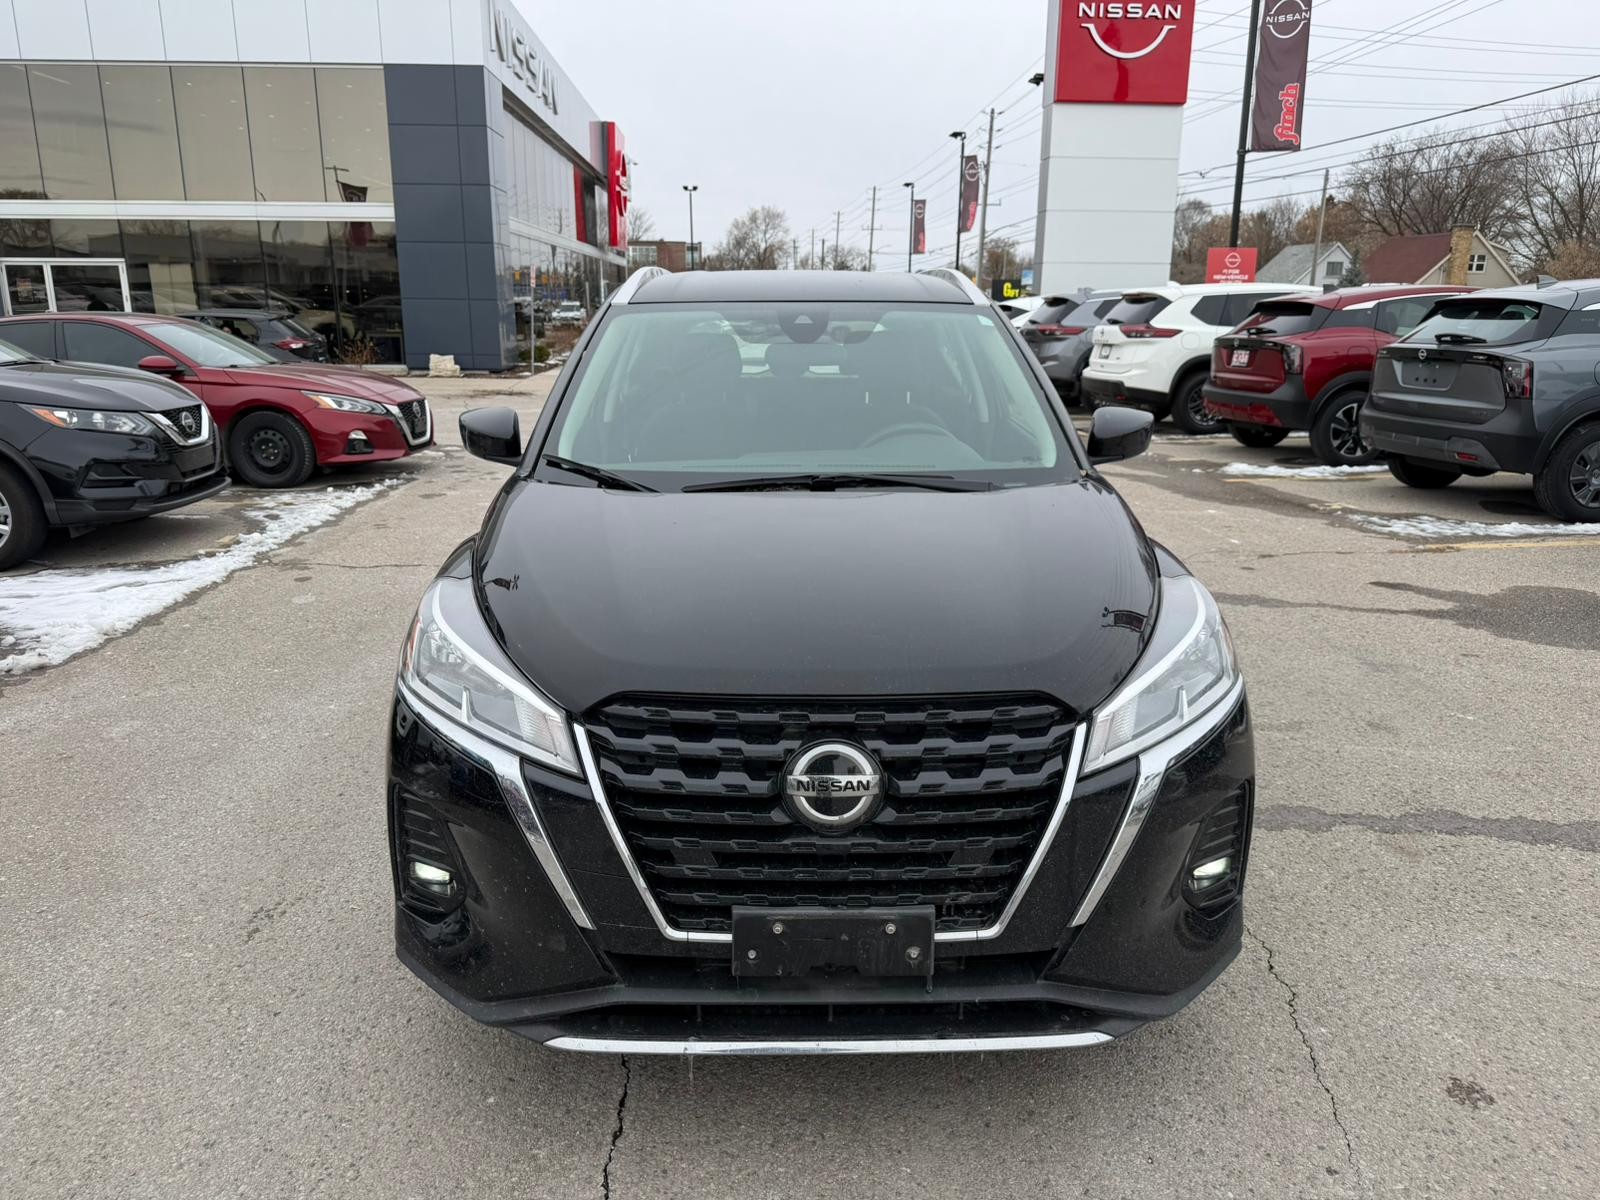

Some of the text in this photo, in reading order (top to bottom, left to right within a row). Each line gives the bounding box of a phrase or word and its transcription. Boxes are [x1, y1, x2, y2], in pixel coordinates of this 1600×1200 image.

[1078, 2, 1182, 19] NISSAN
[1265, 10, 1310, 23] NISSAN
[487, 0, 558, 116] NISSAN
[1273, 82, 1300, 145] finch
[796, 779, 870, 792] NISSAN
